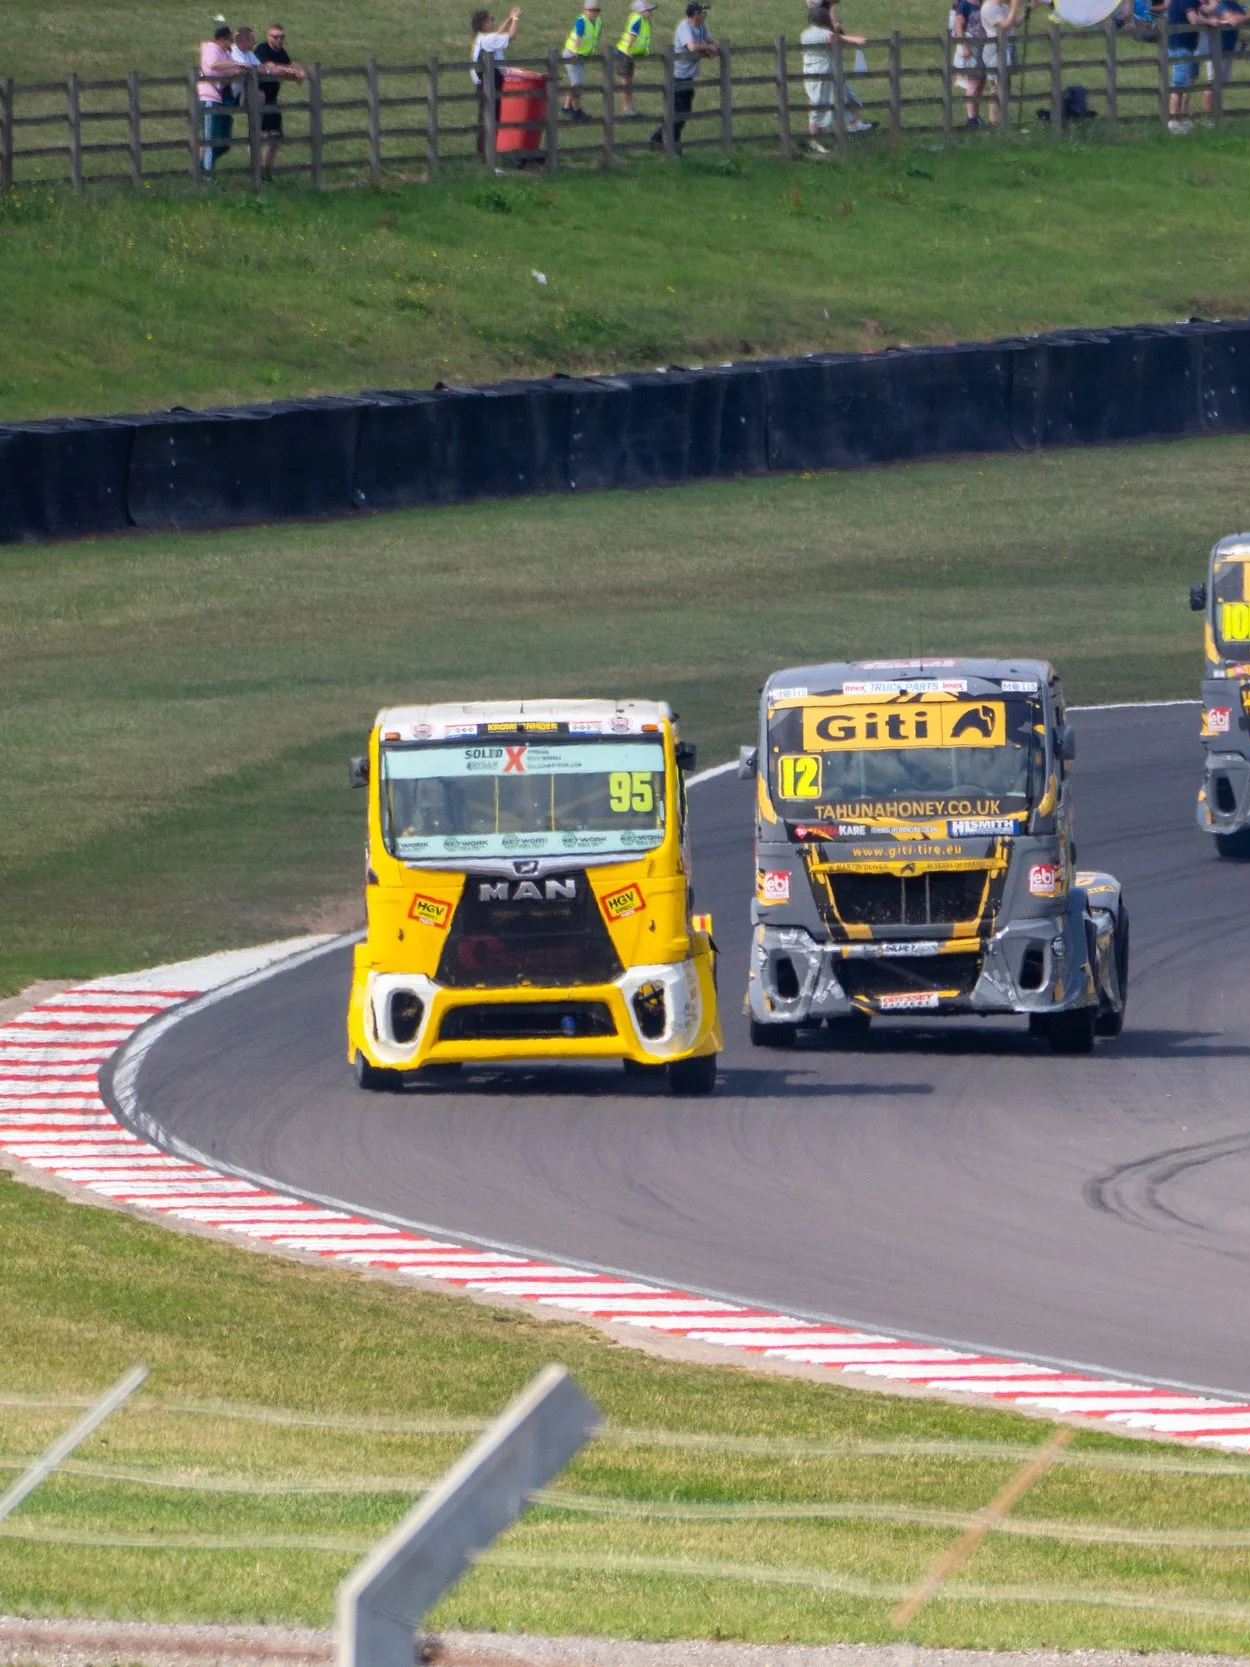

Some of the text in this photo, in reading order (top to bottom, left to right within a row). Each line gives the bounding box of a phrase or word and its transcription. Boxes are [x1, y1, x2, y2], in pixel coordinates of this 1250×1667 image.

[816, 711, 928, 742] Giti
[502, 745, 528, 773] X
[782, 757, 819, 798] 12
[609, 772, 653, 812] 95
[815, 800, 1000, 819] TAHUNAHONEY.CO.UK
[971, 819, 1014, 829] SMITH
[853, 844, 962, 858] www.giti-tire.eu
[1030, 866, 1055, 888] febi
[480, 879, 576, 902] MAN
[608, 890, 635, 910] HGV
[417, 901, 443, 916] HGV
